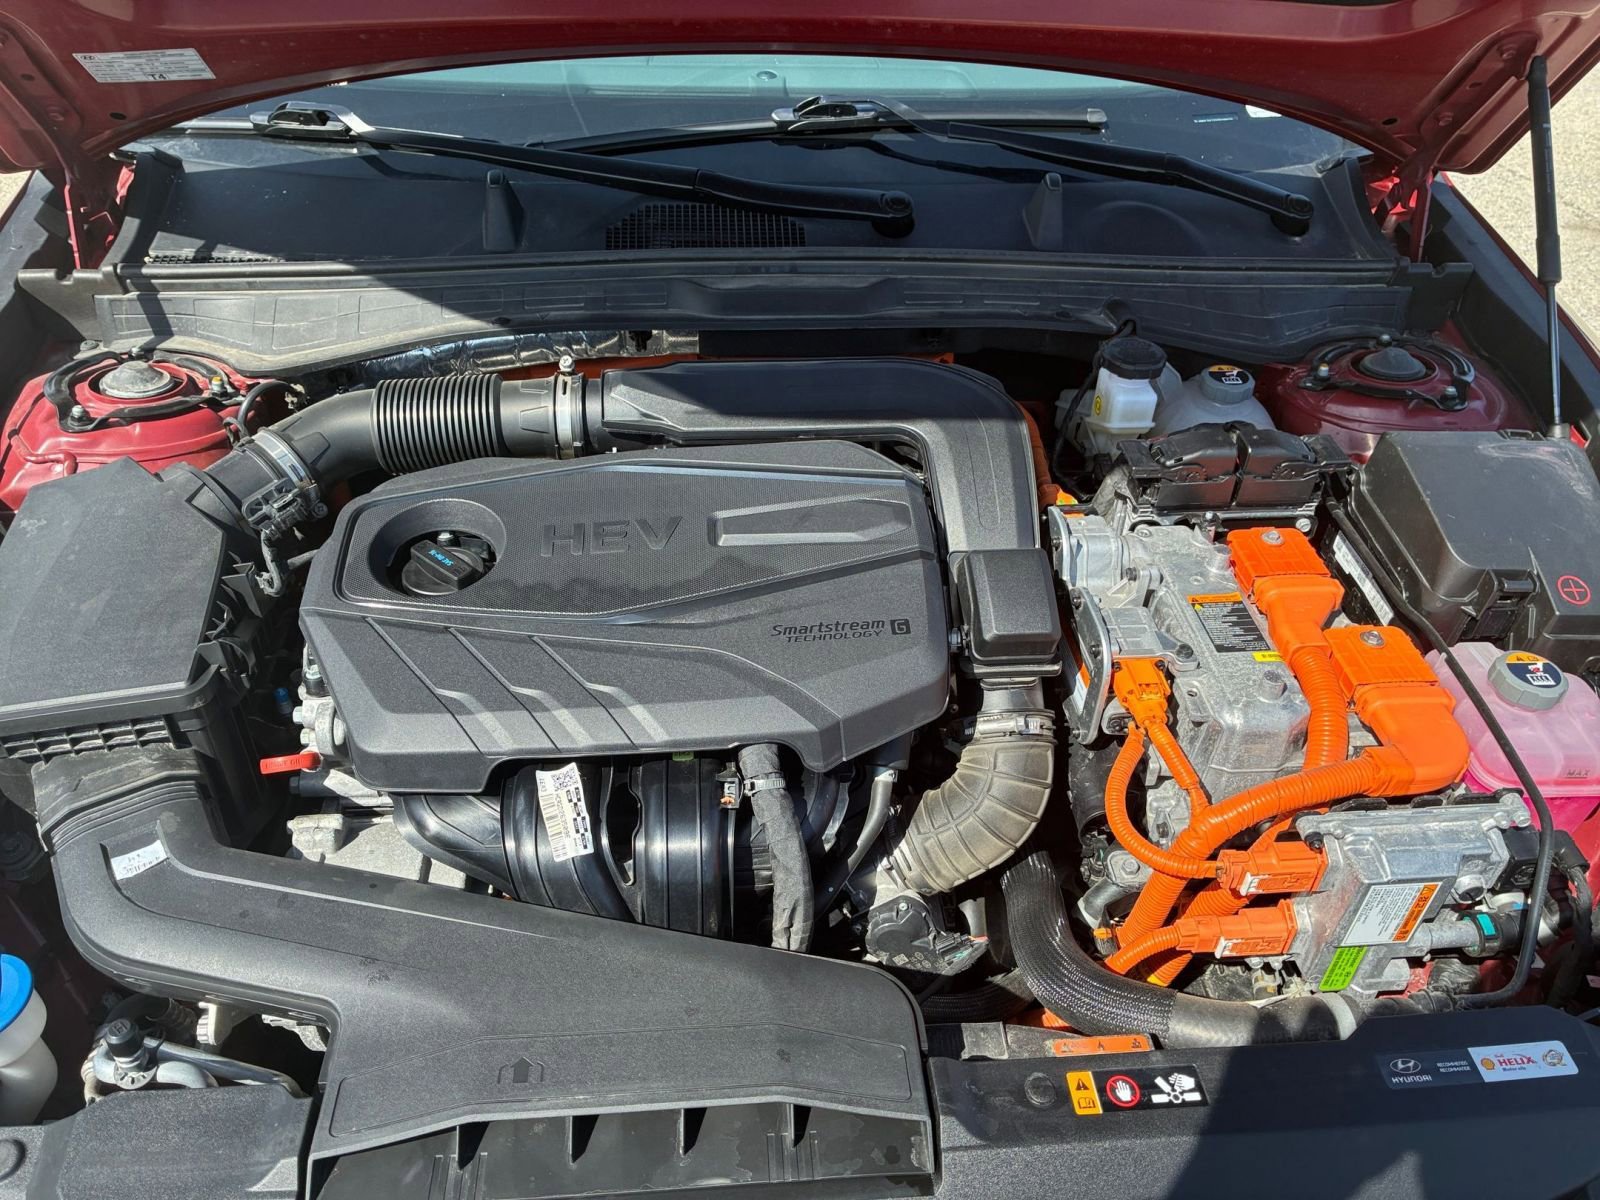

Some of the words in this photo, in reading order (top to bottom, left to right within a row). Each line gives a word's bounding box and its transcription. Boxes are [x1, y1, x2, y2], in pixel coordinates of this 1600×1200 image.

[540, 515, 684, 558] HEV
[770, 619, 886, 637] Smartstream
[785, 629, 883, 643] TECHNOLOGY
[1498, 1056, 1535, 1067] HELIX
[1391, 1074, 1432, 1084] HYUNDAI
